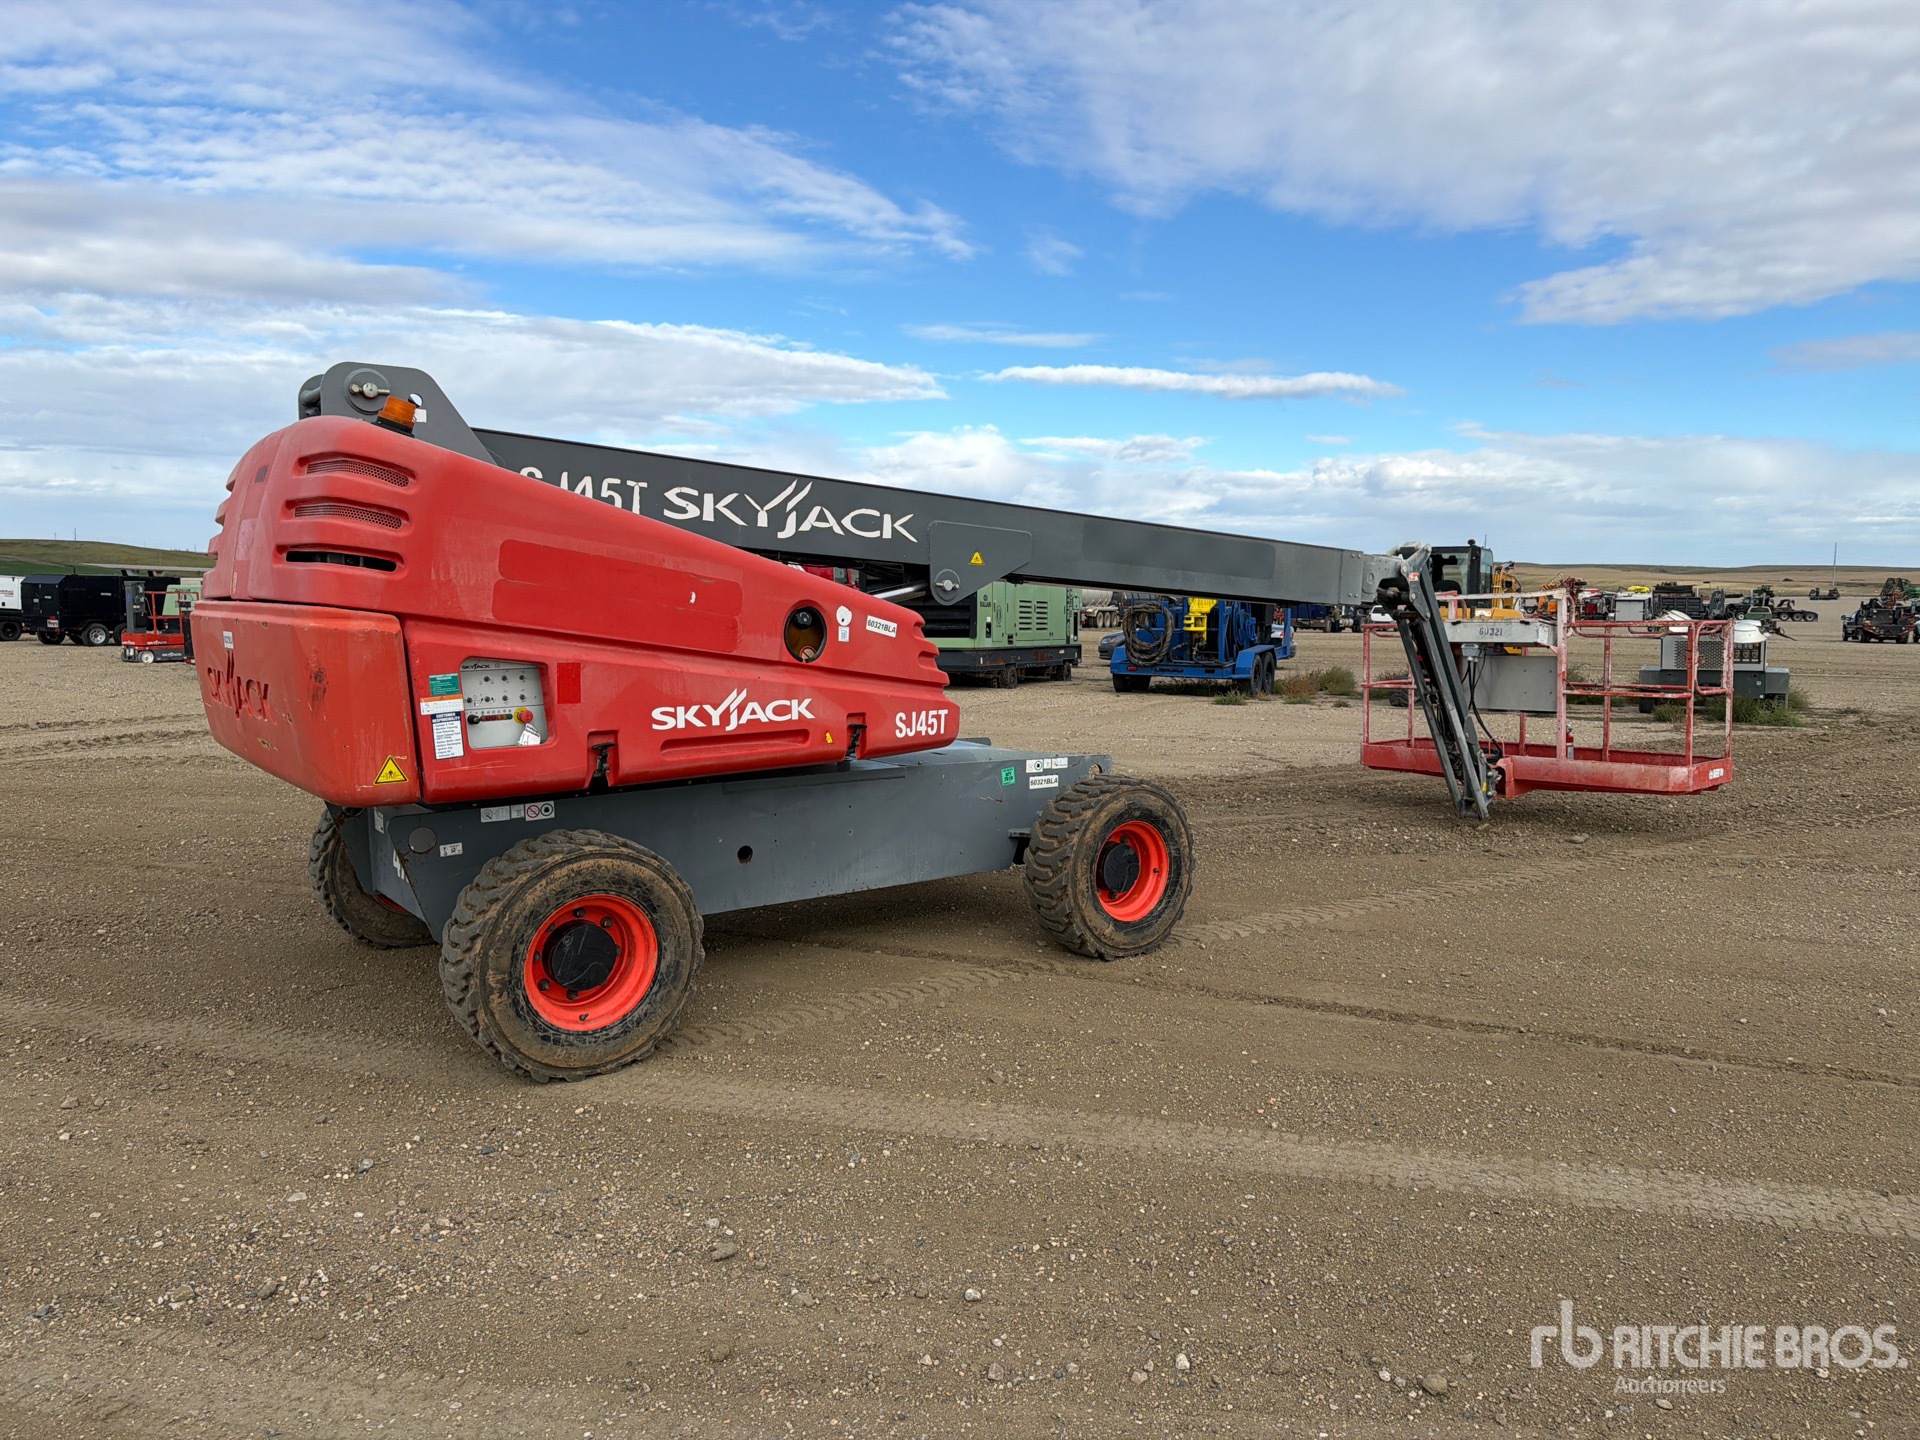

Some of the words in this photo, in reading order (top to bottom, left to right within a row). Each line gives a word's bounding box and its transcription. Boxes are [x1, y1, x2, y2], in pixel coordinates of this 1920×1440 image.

[663, 478, 918, 543] SKYJACK
[867, 619, 896, 633] 60321BLA
[207, 649, 278, 725] SKYJACK
[651, 687, 815, 731] SKYJACK
[895, 709, 949, 738] SJ45T
[1030, 777, 1058, 787] 60321BLA
